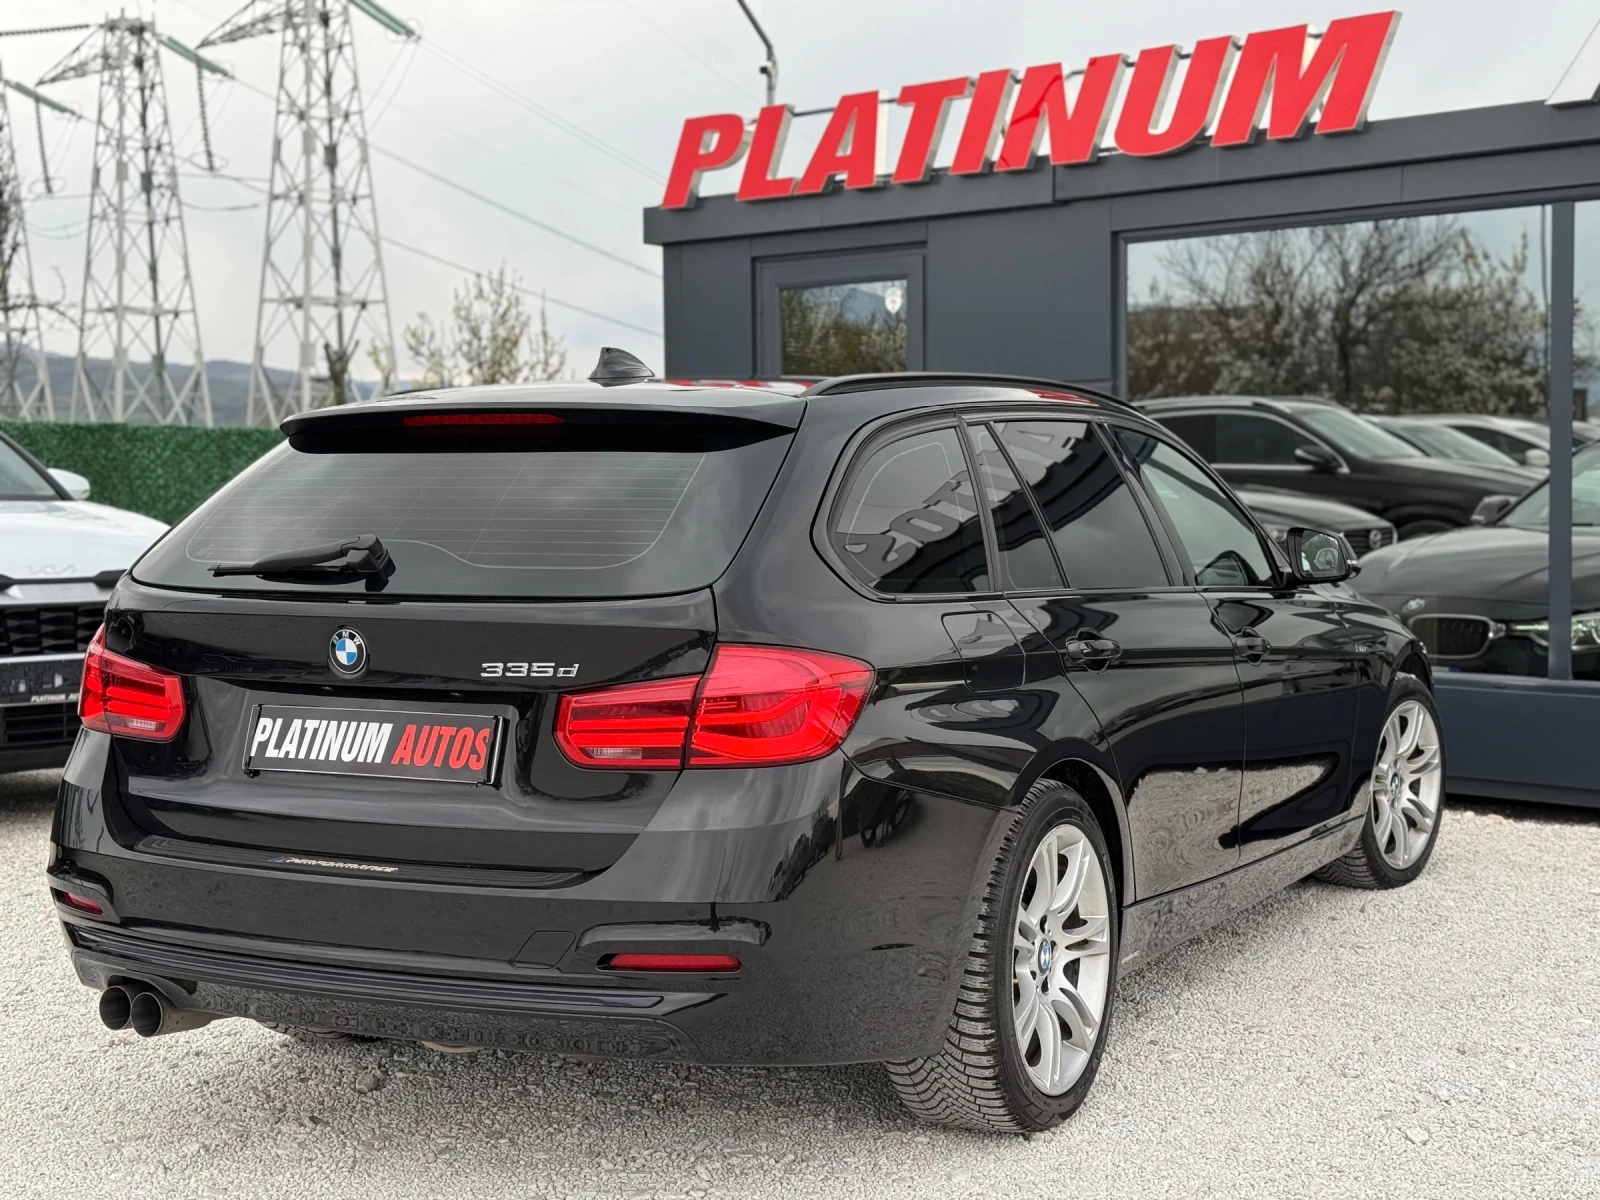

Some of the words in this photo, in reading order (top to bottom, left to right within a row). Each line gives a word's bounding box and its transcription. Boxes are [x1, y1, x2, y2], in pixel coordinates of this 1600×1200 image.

[660, 10, 1402, 209] PLATINUM
[331, 630, 362, 646] BMW
[480, 662, 580, 678] 335d
[30, 693, 66, 703] PLATINUM
[249, 717, 394, 764] PLATINUM
[390, 723, 492, 771] AUTOS
